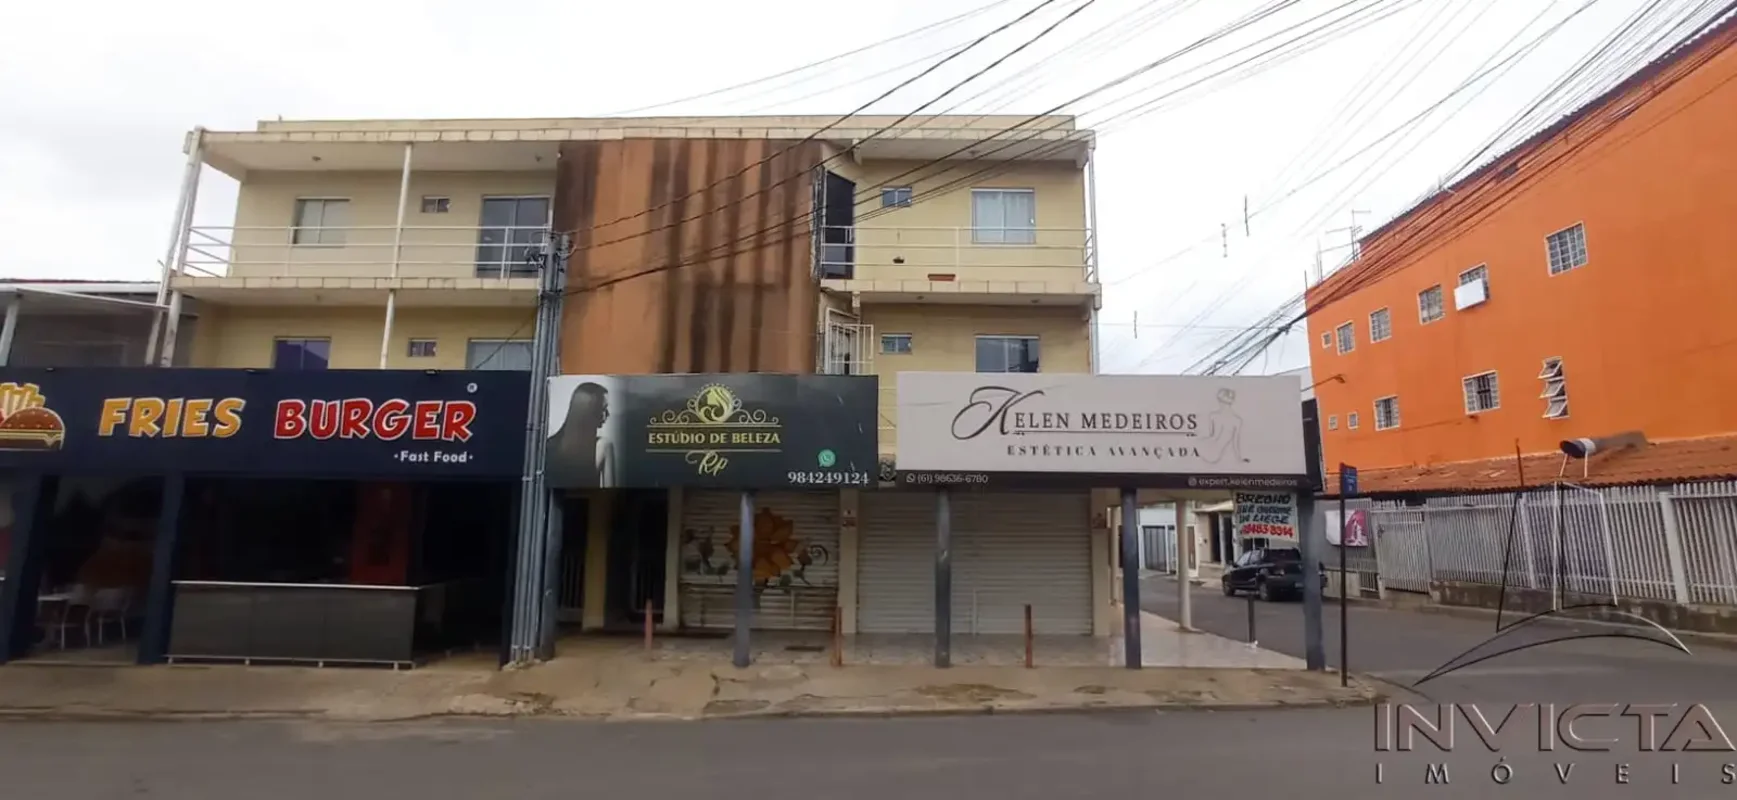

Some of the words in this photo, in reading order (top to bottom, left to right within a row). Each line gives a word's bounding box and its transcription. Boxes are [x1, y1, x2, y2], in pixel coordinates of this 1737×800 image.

[98, 397, 246, 438] FRIES
[274, 397, 477, 443] BURGER
[951, 385, 1070, 440] KELEN
[1081, 412, 1198, 431] MEDEIROS
[648, 430, 705, 444] ESTÚDIO
[710, 432, 728, 444] DE
[732, 432, 780, 444] BELEZA
[400, 450, 429, 462] Fast
[434, 451, 467, 463] Food
[1006, 442, 1097, 457] ESTÉTICA
[1108, 445, 1200, 460] AVANÇADA
[787, 471, 869, 485] 984249124
